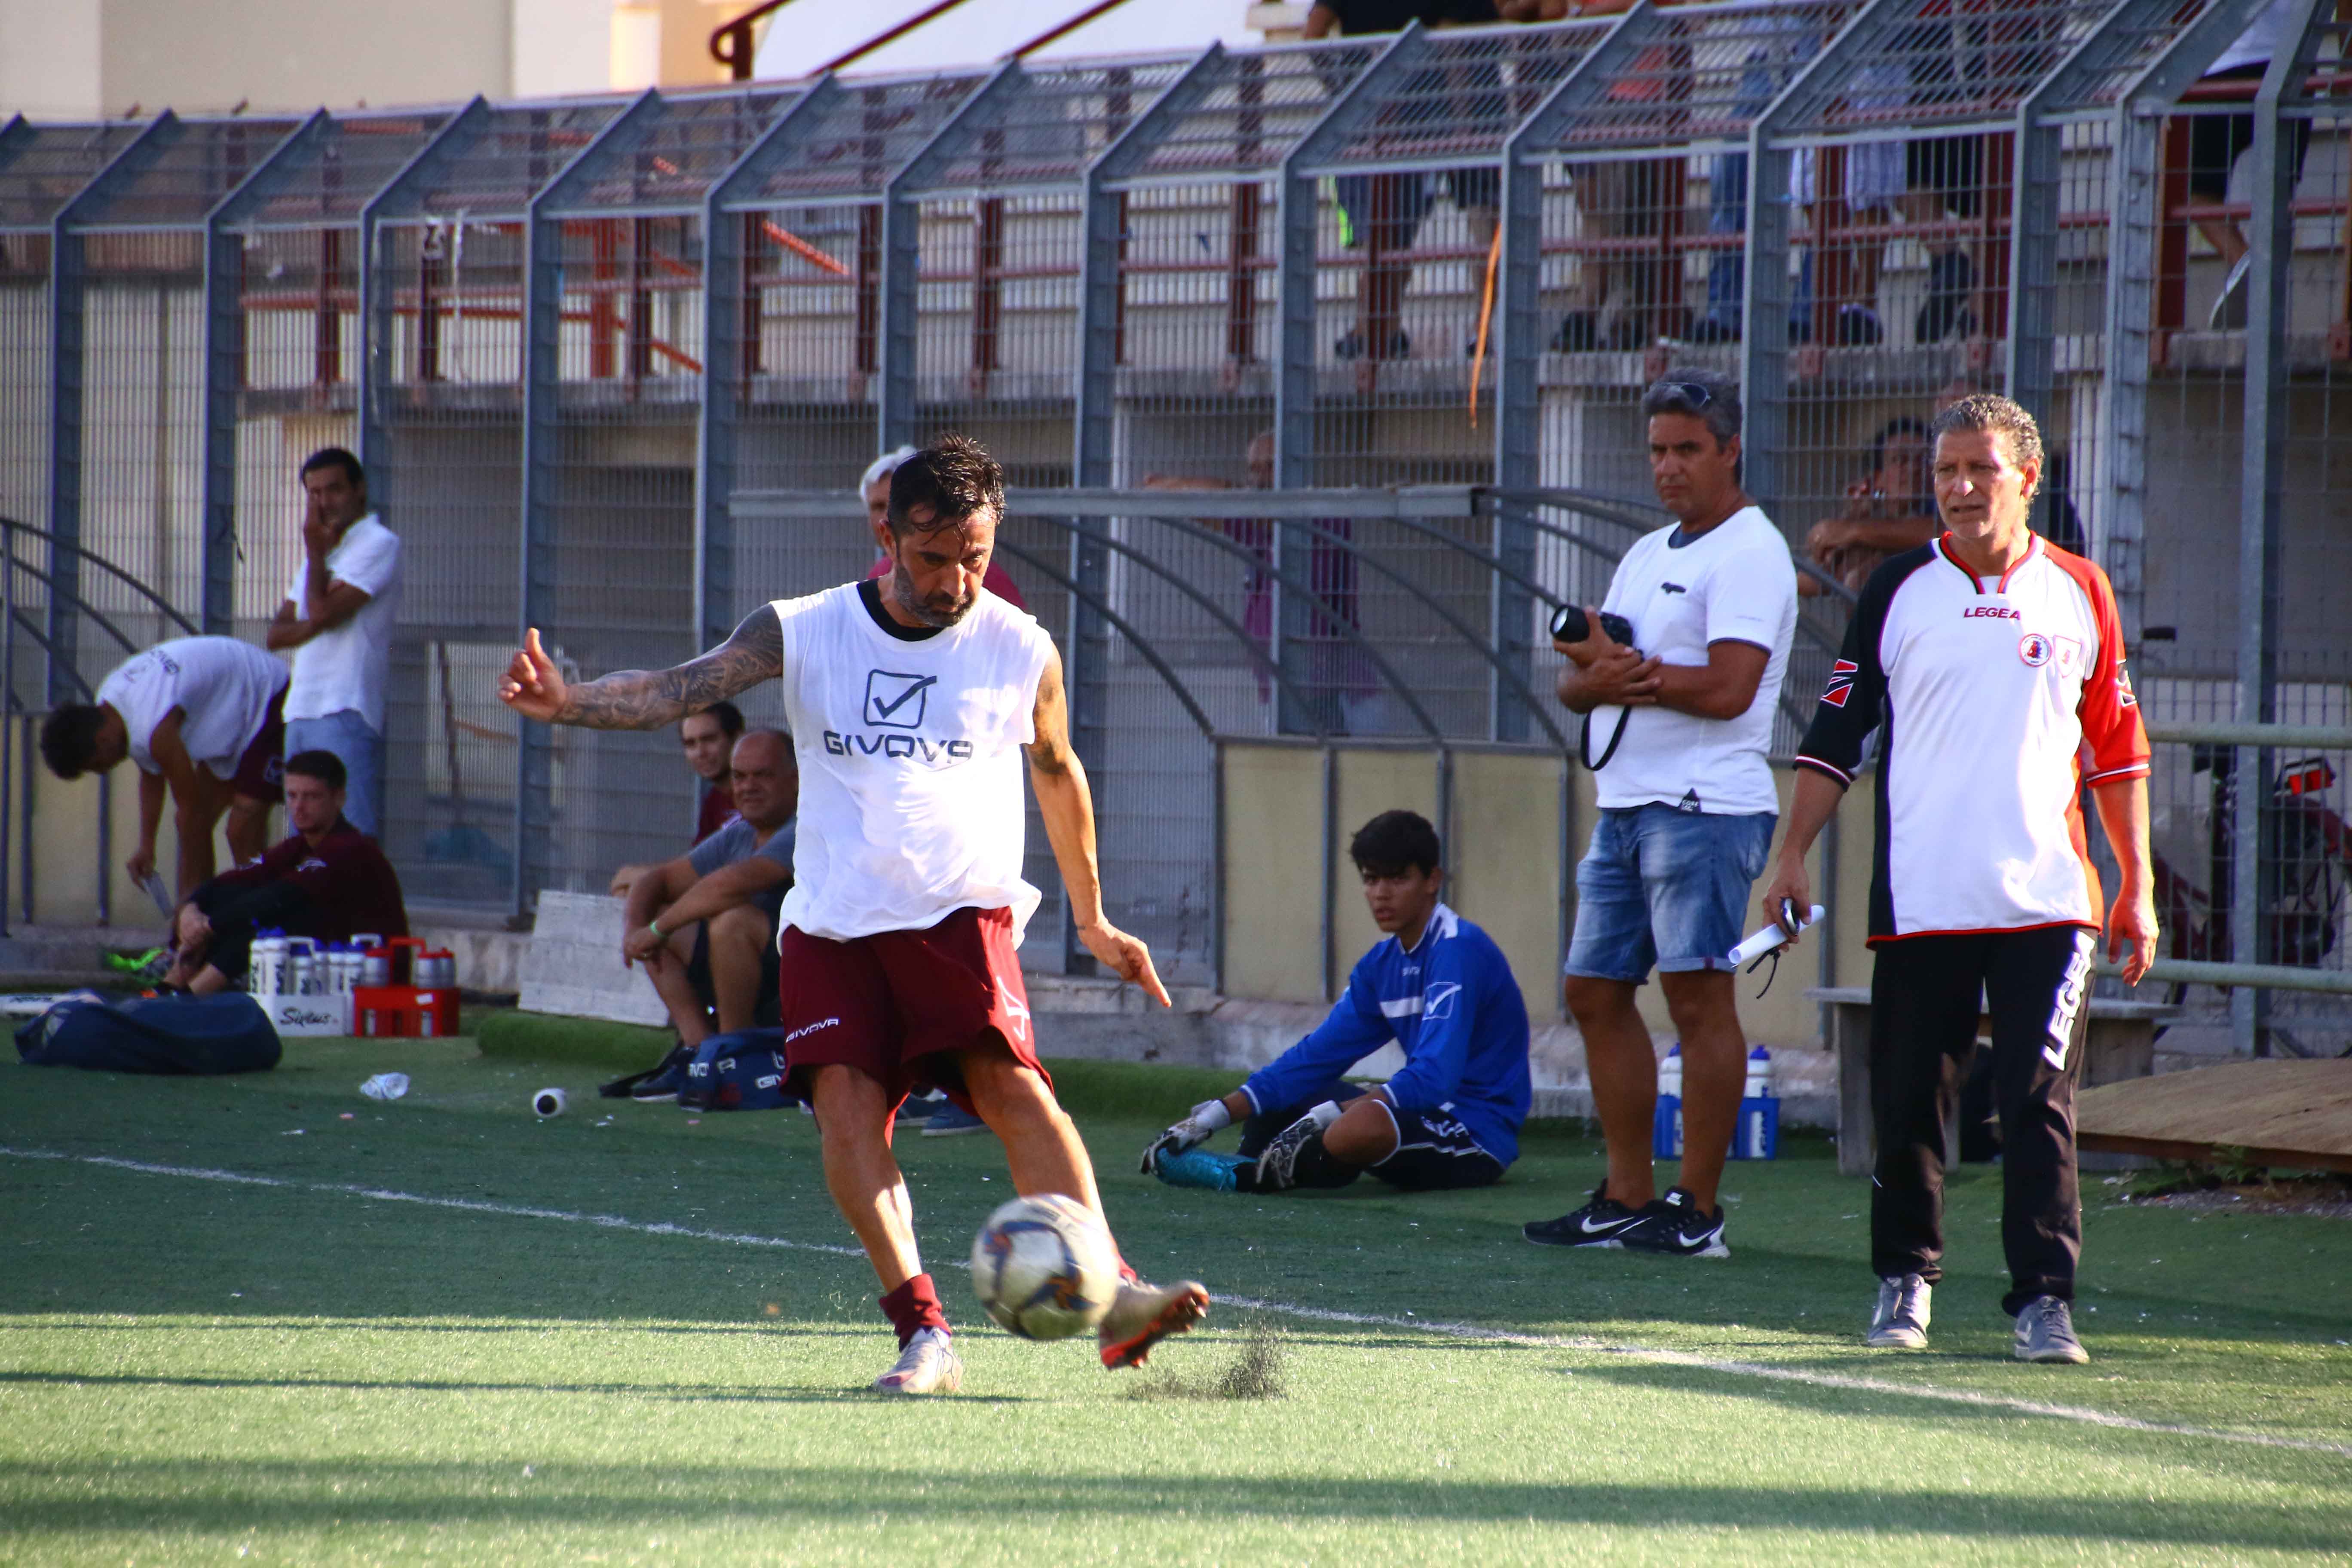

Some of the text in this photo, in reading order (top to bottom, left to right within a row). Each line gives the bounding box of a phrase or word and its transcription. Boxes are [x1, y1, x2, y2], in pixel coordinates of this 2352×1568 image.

[1964, 607, 2020, 620] LEGEA
[824, 731, 974, 764] GIVOVA
[785, 1018, 839, 1043] GIVOVA
